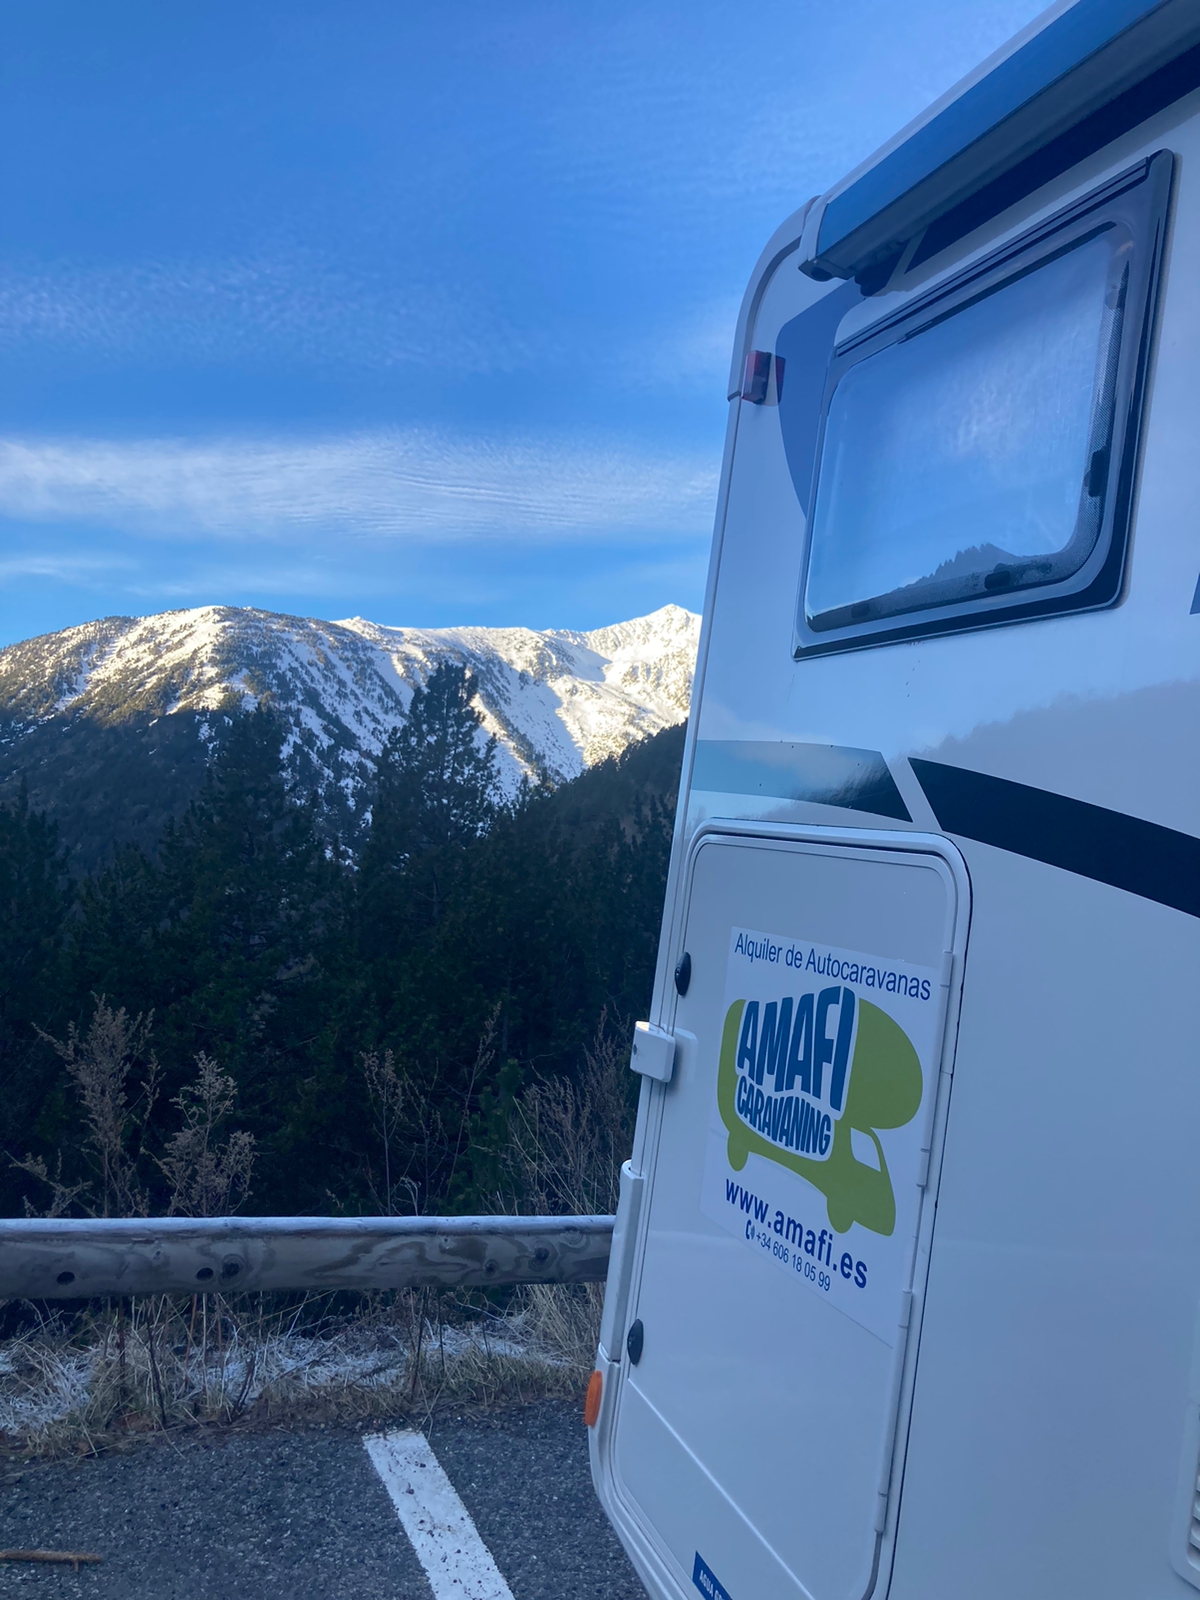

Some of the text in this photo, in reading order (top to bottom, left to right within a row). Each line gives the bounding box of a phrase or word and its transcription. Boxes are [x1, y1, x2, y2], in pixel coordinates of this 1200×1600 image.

[734, 932, 931, 1001] Alquiler de Autocaravanas
[737, 985, 856, 1112] AMAFI
[737, 1075, 831, 1155] CARAVANING
[725, 1178, 868, 1289] www.amafi.es
[756, 1231, 831, 1291] +34 606 18 05 99
